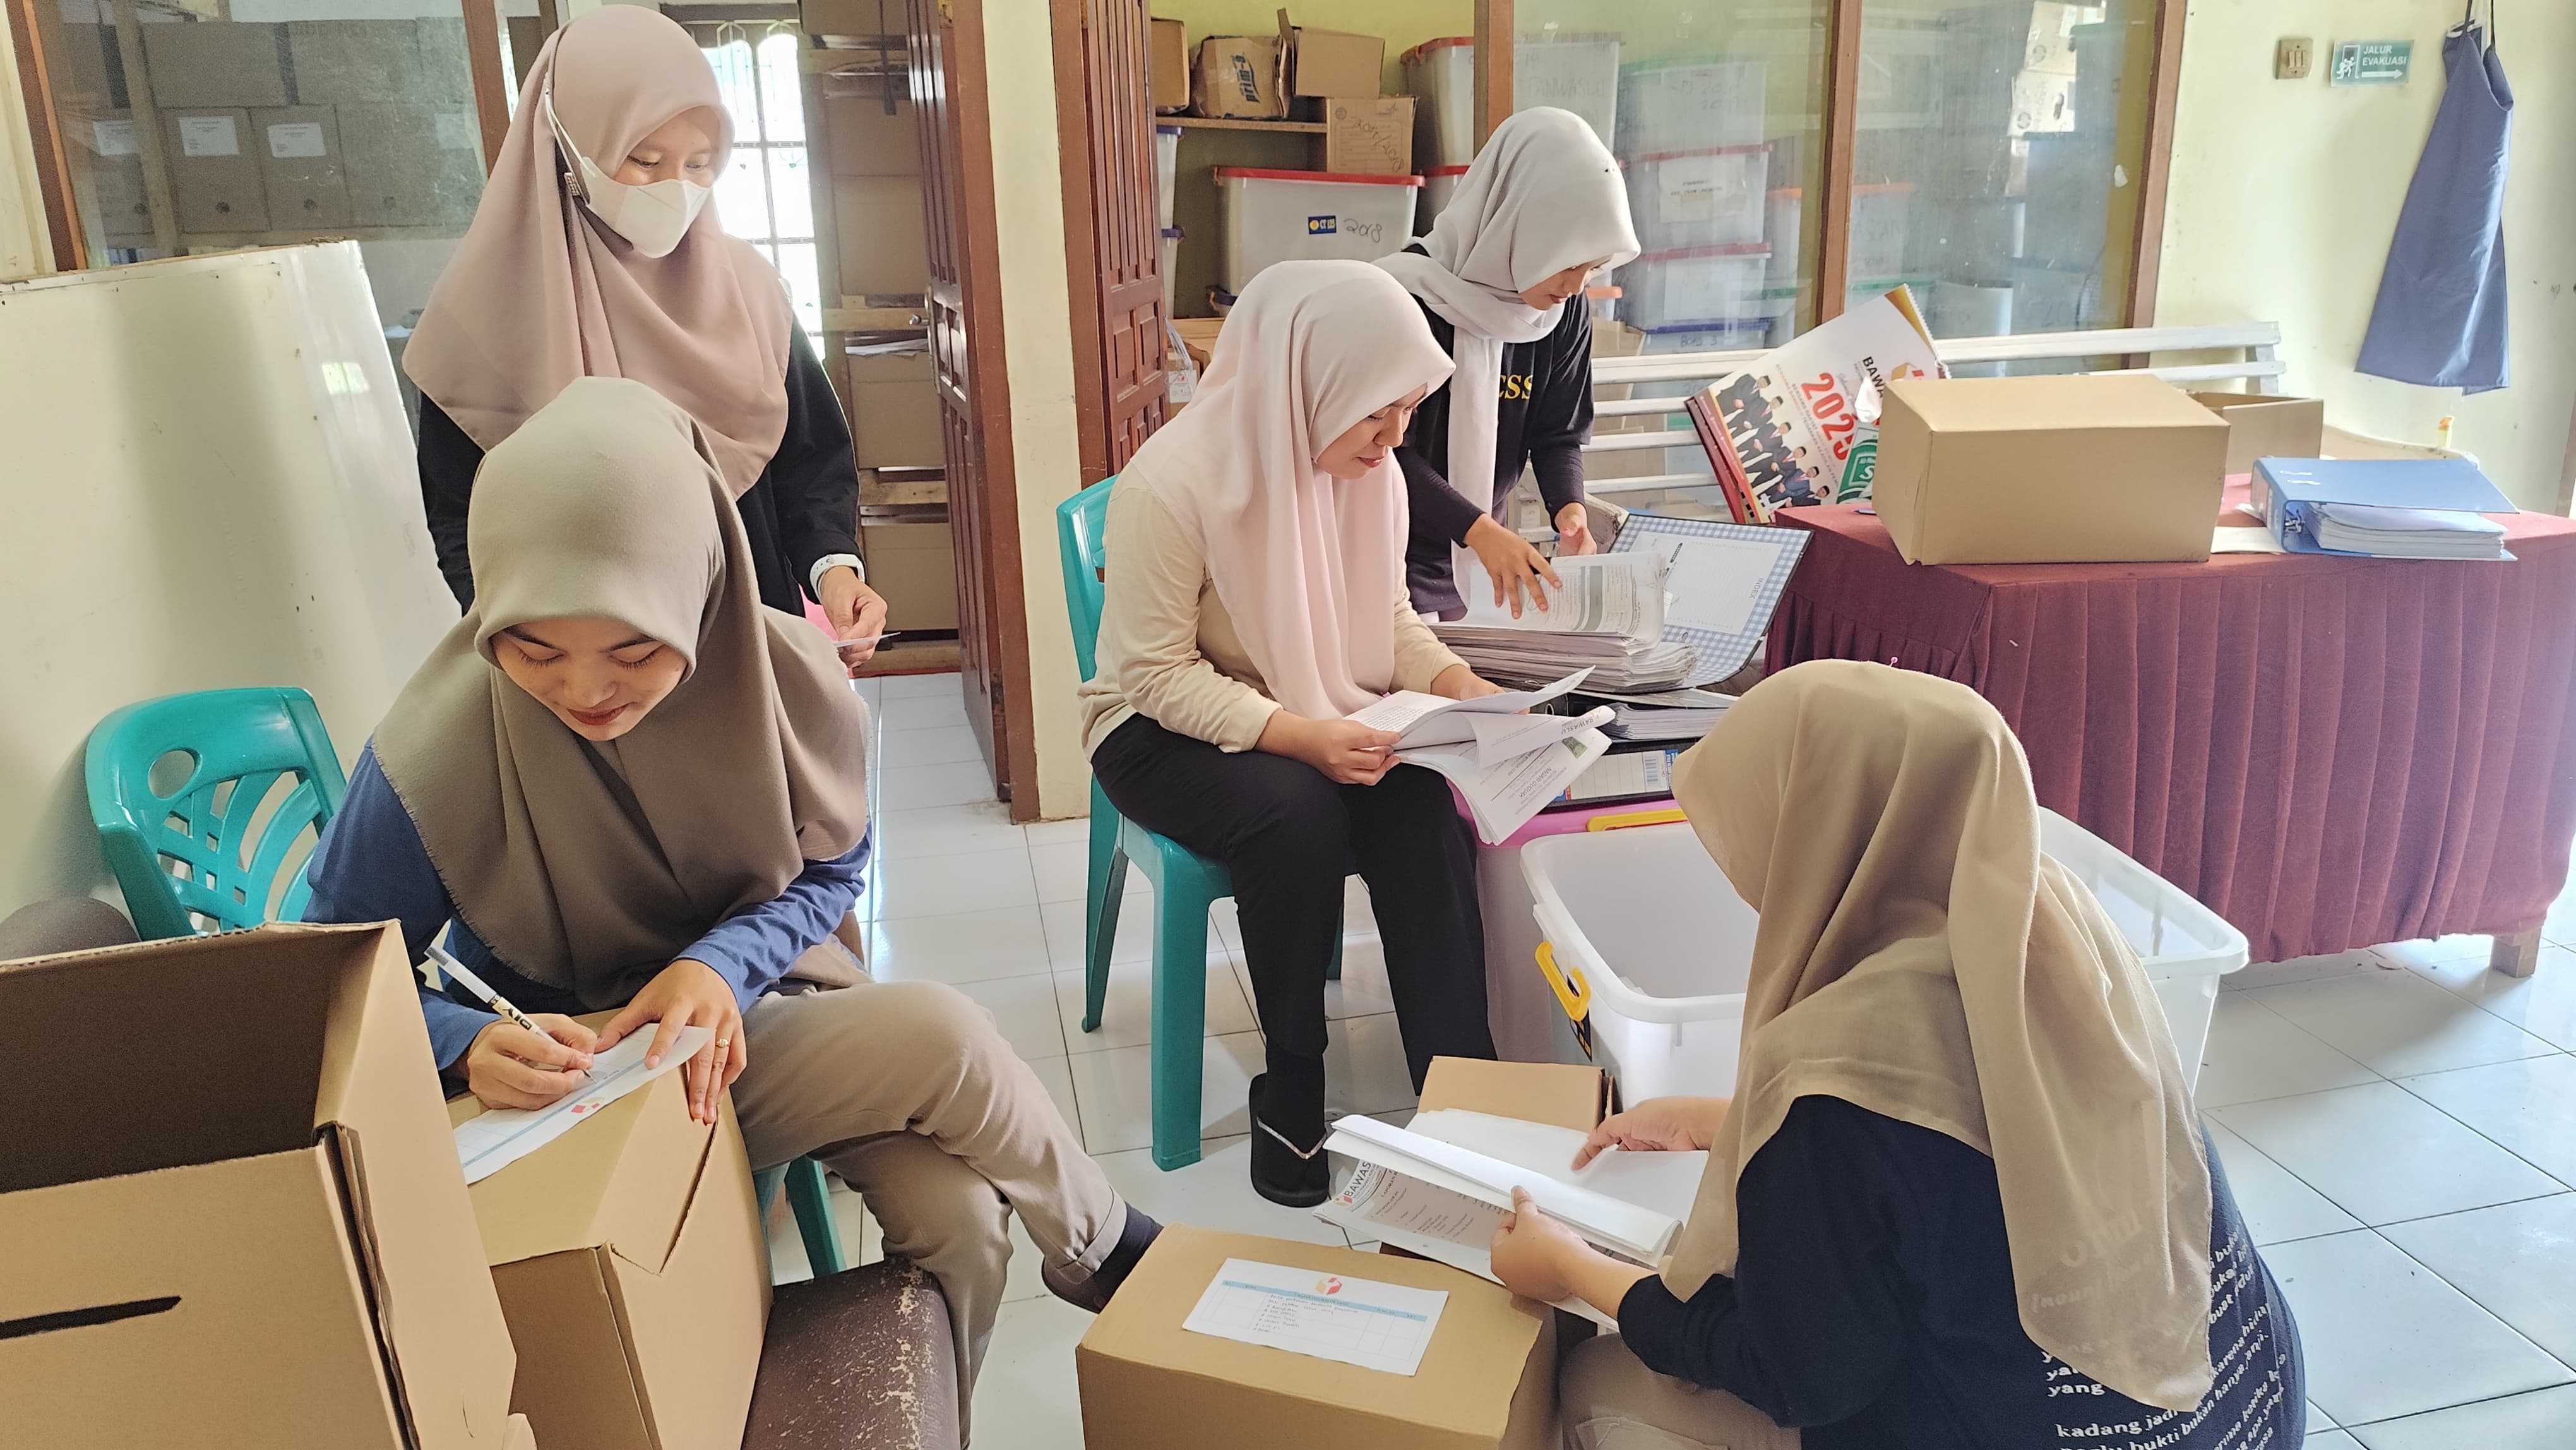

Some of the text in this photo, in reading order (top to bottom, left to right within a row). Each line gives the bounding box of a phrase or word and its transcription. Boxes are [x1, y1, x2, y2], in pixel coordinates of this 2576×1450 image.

[2363, 45, 2393, 55] JALUR
[2362, 56, 2407, 66] EVAKUASI
[1748, 577, 1763, 599] INDEX
[1561, 716, 1594, 735] BAWASLU
[1535, 767, 1551, 782] NAGARI
[1344, 1161, 1371, 1197] BAWAS
[2048, 1383, 2106, 1398] yang
[2128, 1428, 2180, 1450] bukti
[2180, 1398, 2215, 1435] bukan
[2214, 1363, 2245, 1401] hanya
[2054, 1421, 2143, 1437] kadang
[2145, 1408, 2179, 1431] jadi
